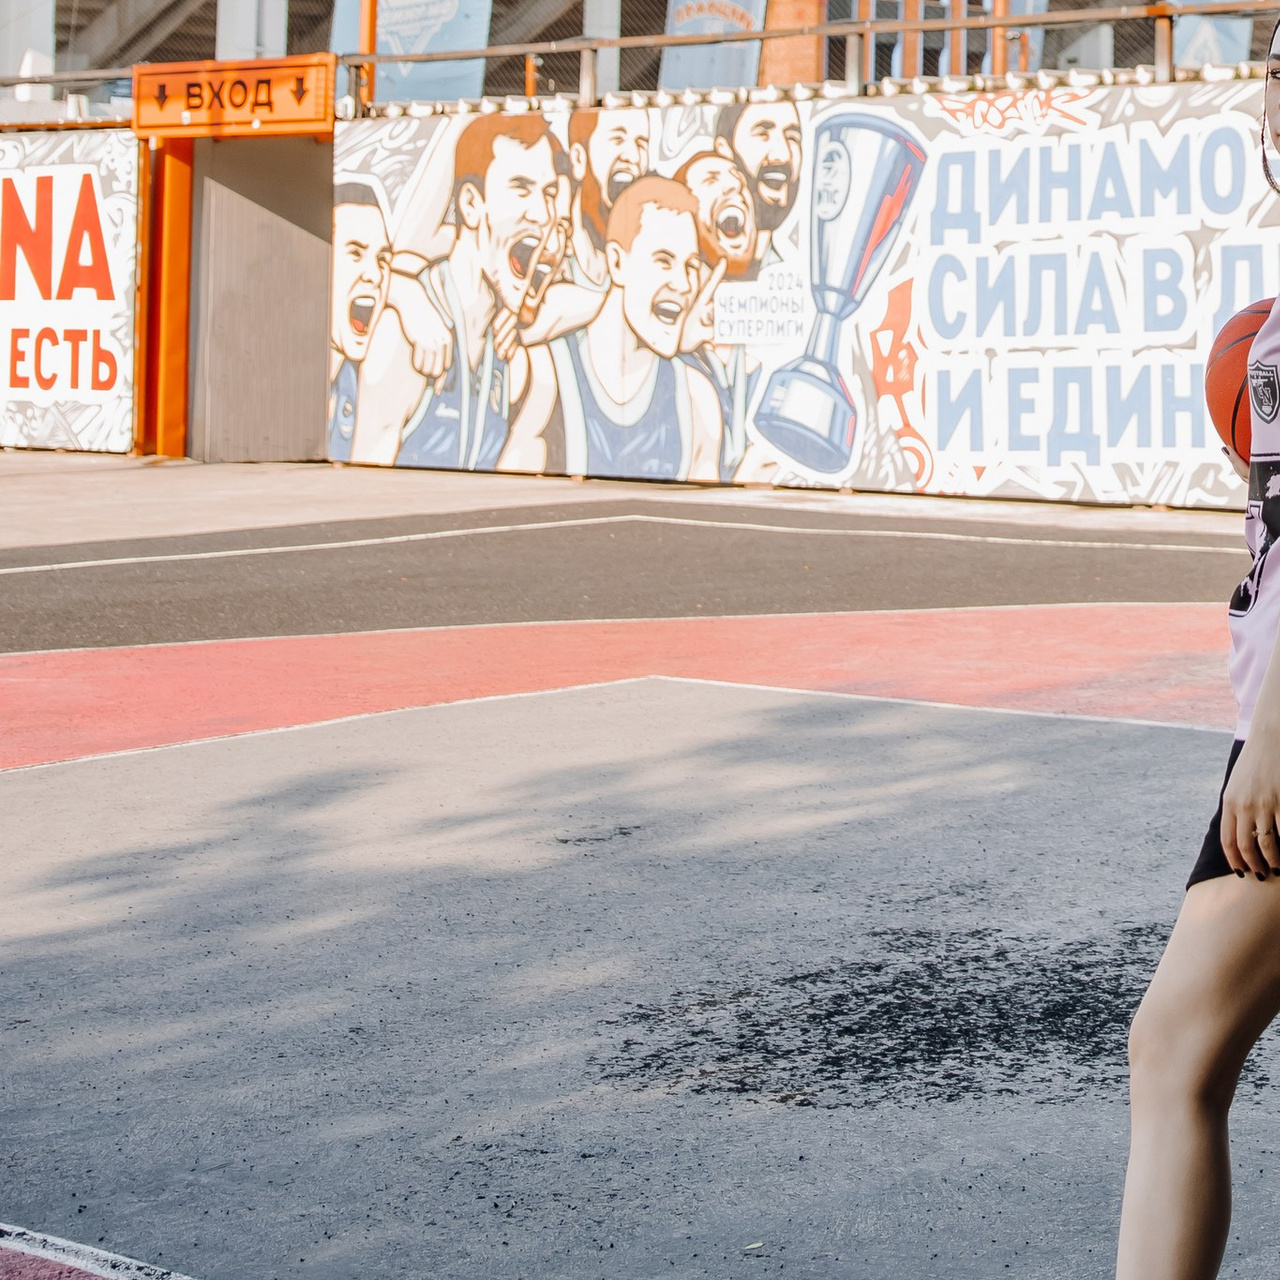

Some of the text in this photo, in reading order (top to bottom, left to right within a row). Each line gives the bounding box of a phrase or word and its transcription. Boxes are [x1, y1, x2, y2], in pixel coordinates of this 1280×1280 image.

[185, 79, 273, 114] ВХОД
[929, 126, 1246, 246] ДИНАМО
[720, 297, 804, 313] ЧЕМПИОНЫ
[769, 274, 803, 290] 2024
[927, 251, 1120, 340] СИЛА
[1143, 248, 1188, 332] В
[719, 321, 803, 337] СУПЕРЛИГИ
[9, 327, 118, 391] ЕСТЬ
[937, 369, 984, 451] И
